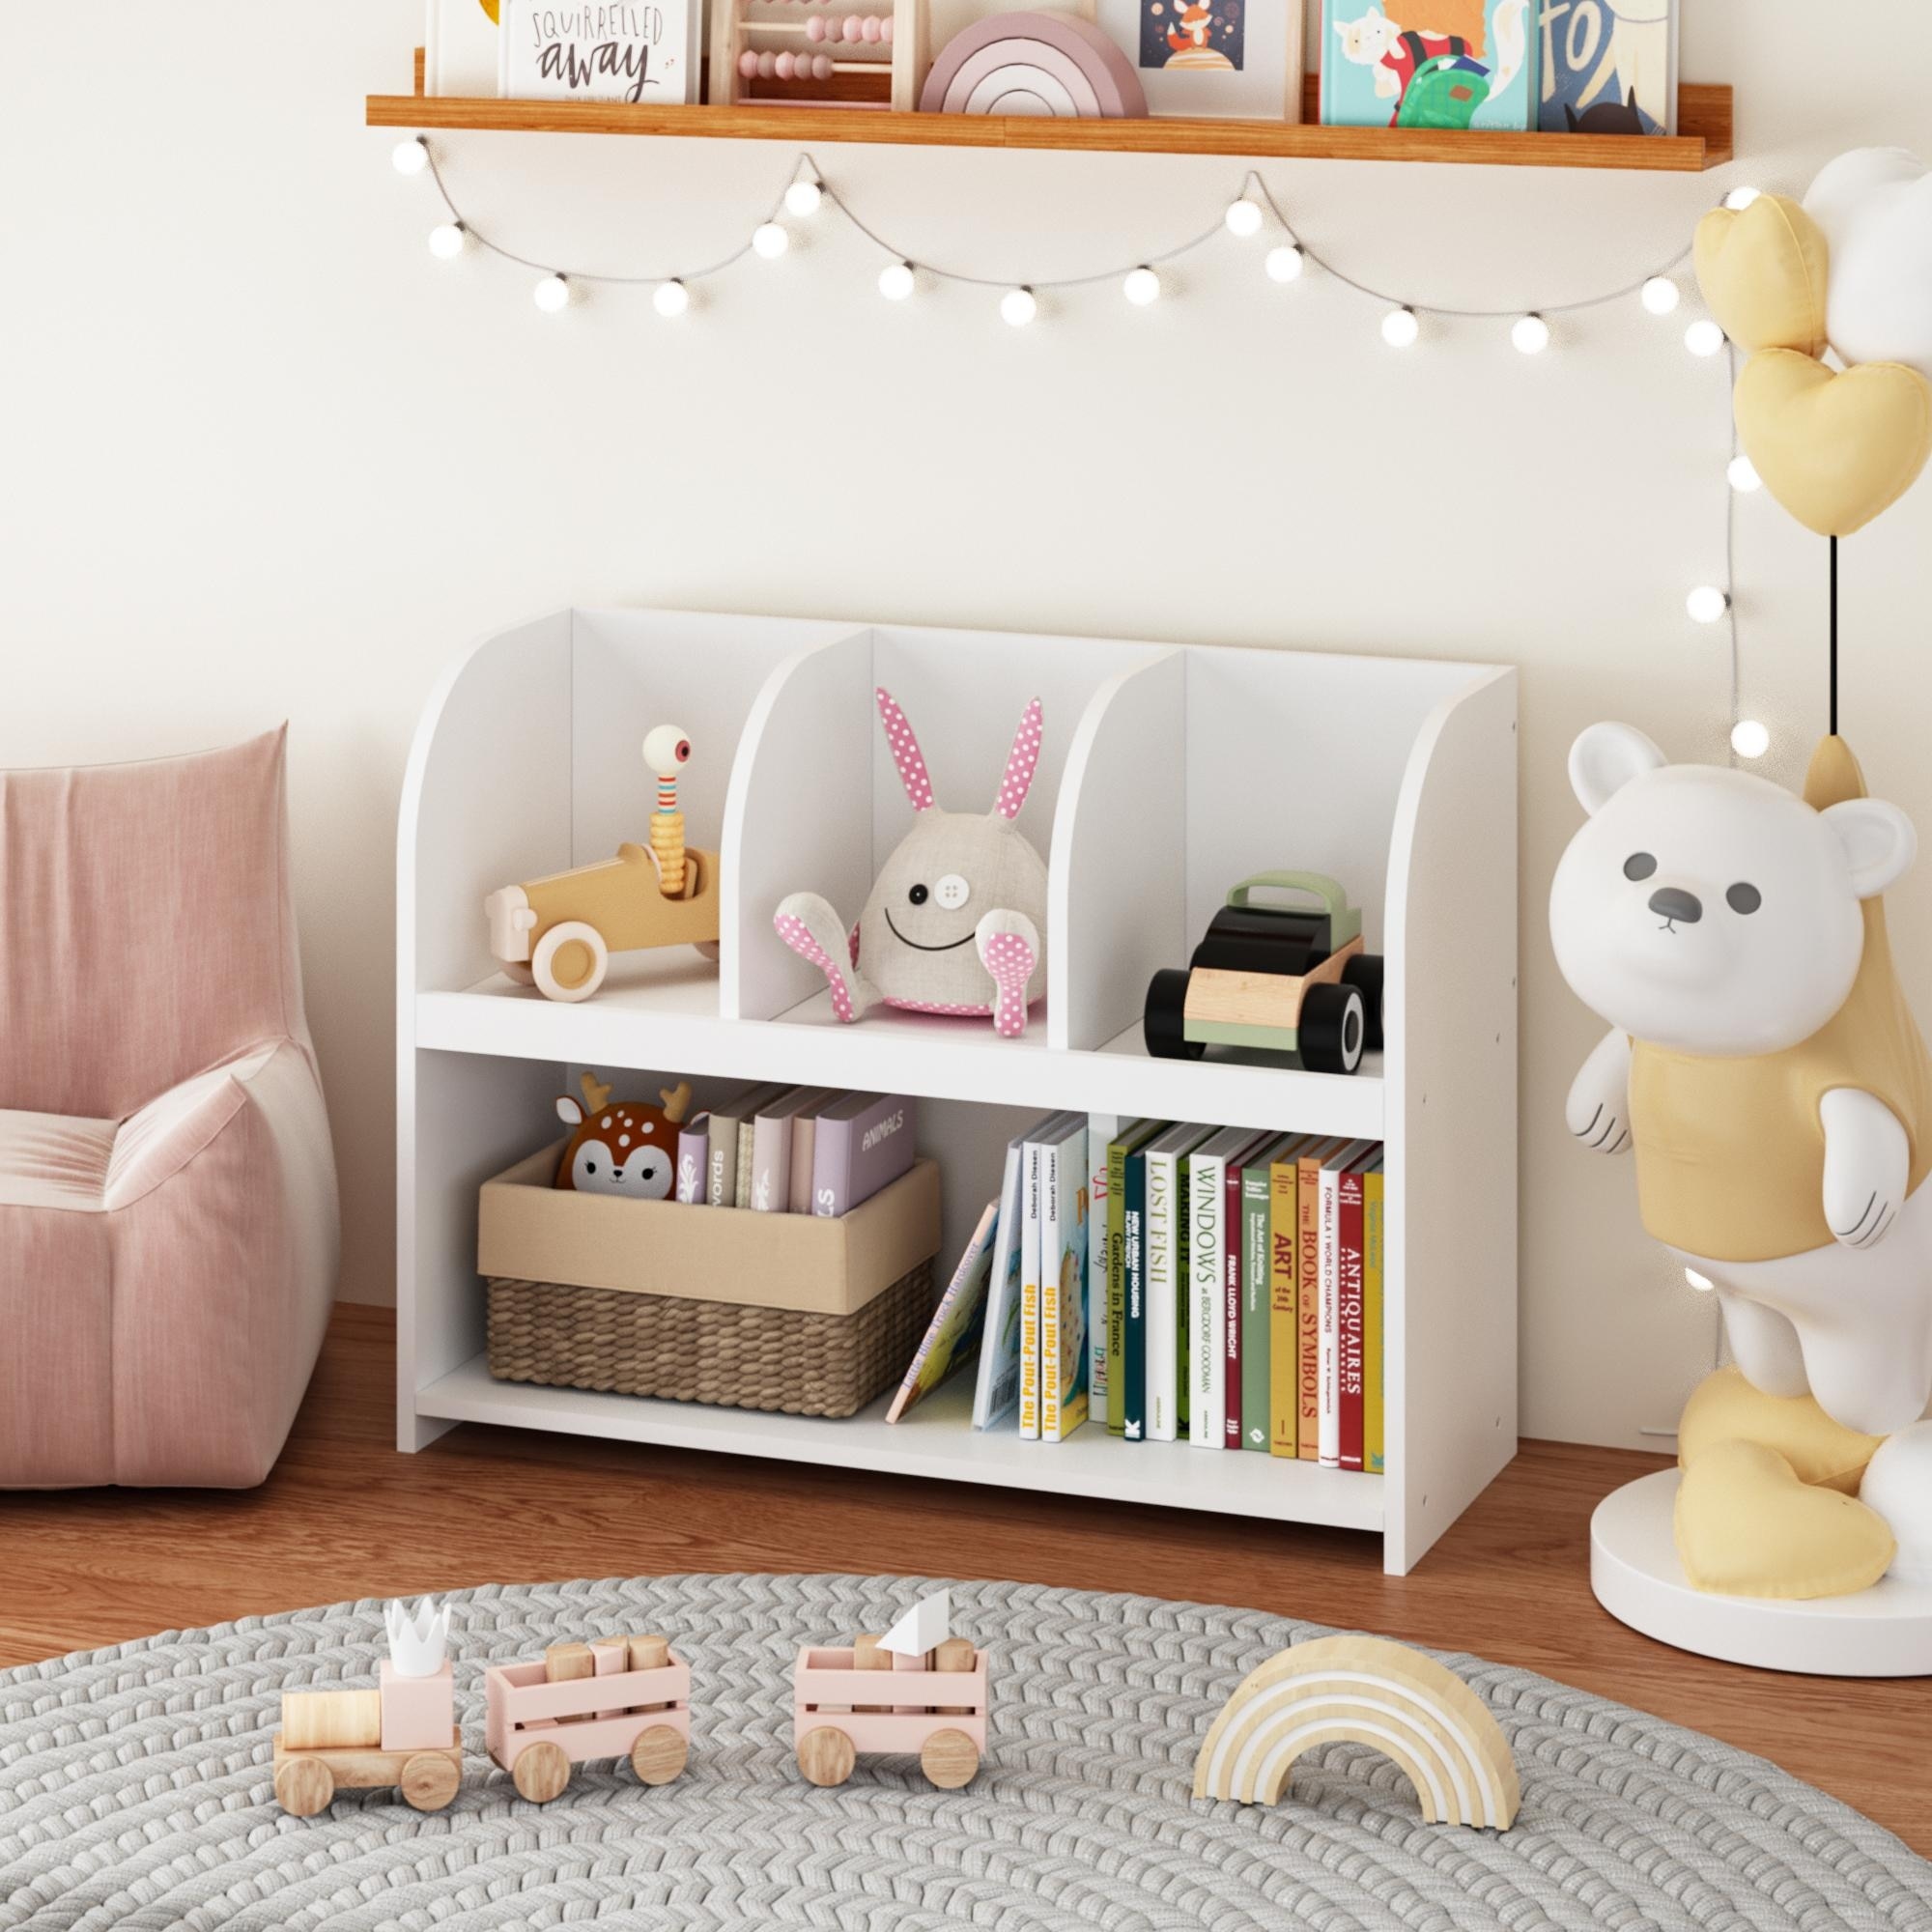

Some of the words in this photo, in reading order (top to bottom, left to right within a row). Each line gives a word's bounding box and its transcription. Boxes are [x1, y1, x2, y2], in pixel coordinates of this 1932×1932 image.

[533, 4, 663, 47] SQUIRRELLED
[536, 42, 660, 103] away
[863, 1110, 903, 1151] ANIMALS
[1151, 1161, 1167, 1224] LOST
[1131, 1210, 1140, 1236] NEW
[1197, 1166, 1216, 1284] WINDOWS
[1112, 1232, 1123, 1290] Gardens
[1131, 1236, 1140, 1271] URBAN
[1151, 1231, 1167, 1283] FISH
[1228, 1254, 1236, 1287] FRANK
[1274, 1232, 1293, 1280] ART
[1302, 1231, 1318, 1290] BOOK
[1024, 1284, 1037, 1317] Fish
[1044, 1286, 1057, 1320] Fish
[1112, 1292, 1123, 1306] in
[1131, 1271, 1140, 1319] HOUSING
[1228, 1287, 1236, 1320] LLOYD
[918, 1330, 937, 1357] Blue
[930, 1296, 952, 1328] Truck
[1112, 1310, 1123, 1357] France
[1228, 1320, 1236, 1360] WRIGHT
[1345, 1247, 1361, 1394] ANTIQUAIRES
[1022, 1321, 1037, 1397] Pout-Pout
[1044, 1322, 1057, 1400] Pout-Pout
[1302, 1313, 1318, 1418] SYMBOLS
[1022, 1401, 1036, 1428] The
[1044, 1404, 1057, 1431] The
